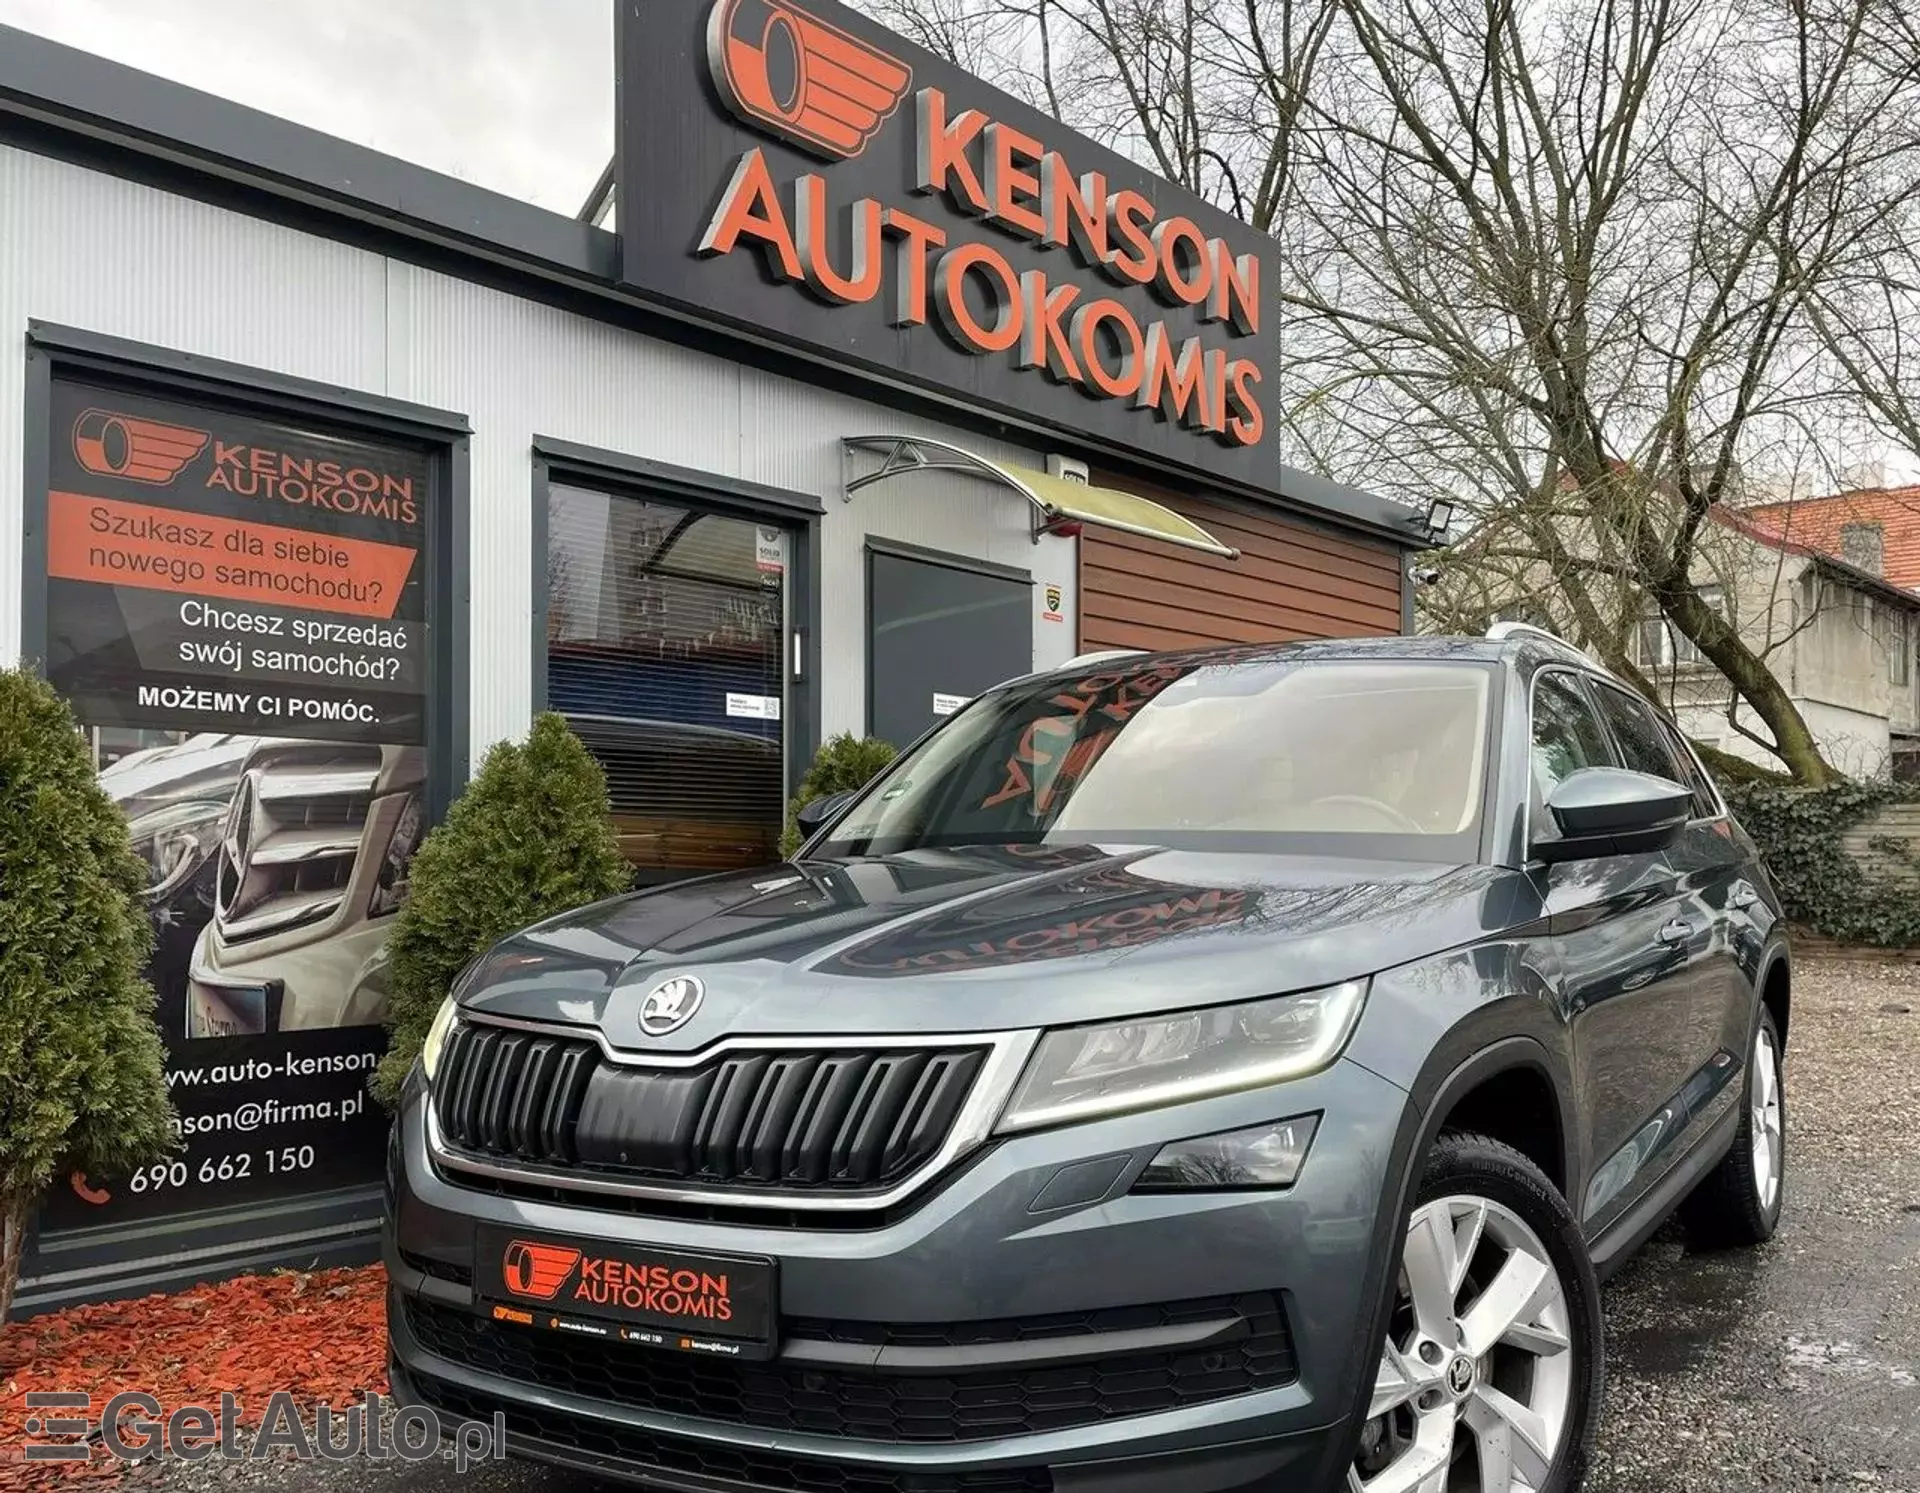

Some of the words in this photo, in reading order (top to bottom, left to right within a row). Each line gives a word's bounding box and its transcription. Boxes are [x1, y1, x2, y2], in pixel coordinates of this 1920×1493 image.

[915, 87, 1258, 336] KENSON
[698, 146, 1264, 448] AUTOKOMIS
[214, 440, 412, 500] KENSON
[205, 466, 417, 524] AUTOKOMIS
[89, 507, 214, 549] Szukasz
[224, 529, 264, 556] dla
[273, 539, 349, 568] siebie
[89, 545, 205, 584] nowego
[215, 564, 382, 604] samochodu?
[179, 601, 283, 636] Chcesz
[292, 615, 408, 650] sprzedać
[179, 641, 242, 673] swój
[252, 647, 400, 681] samochód?
[138, 685, 250, 714] MOŻEMY
[257, 691, 281, 716] CI
[288, 692, 381, 723] POMÓC.
[164, 1051, 375, 1087] ww.auto-kenson
[167, 1090, 363, 1134] nson@firma.pl
[130, 1162, 187, 1193] 690
[199, 1153, 252, 1183] 662
[265, 1145, 315, 1175] 150
[574, 1279, 732, 1320] AUTOKOMIS
[581, 1257, 728, 1297] KENSON
